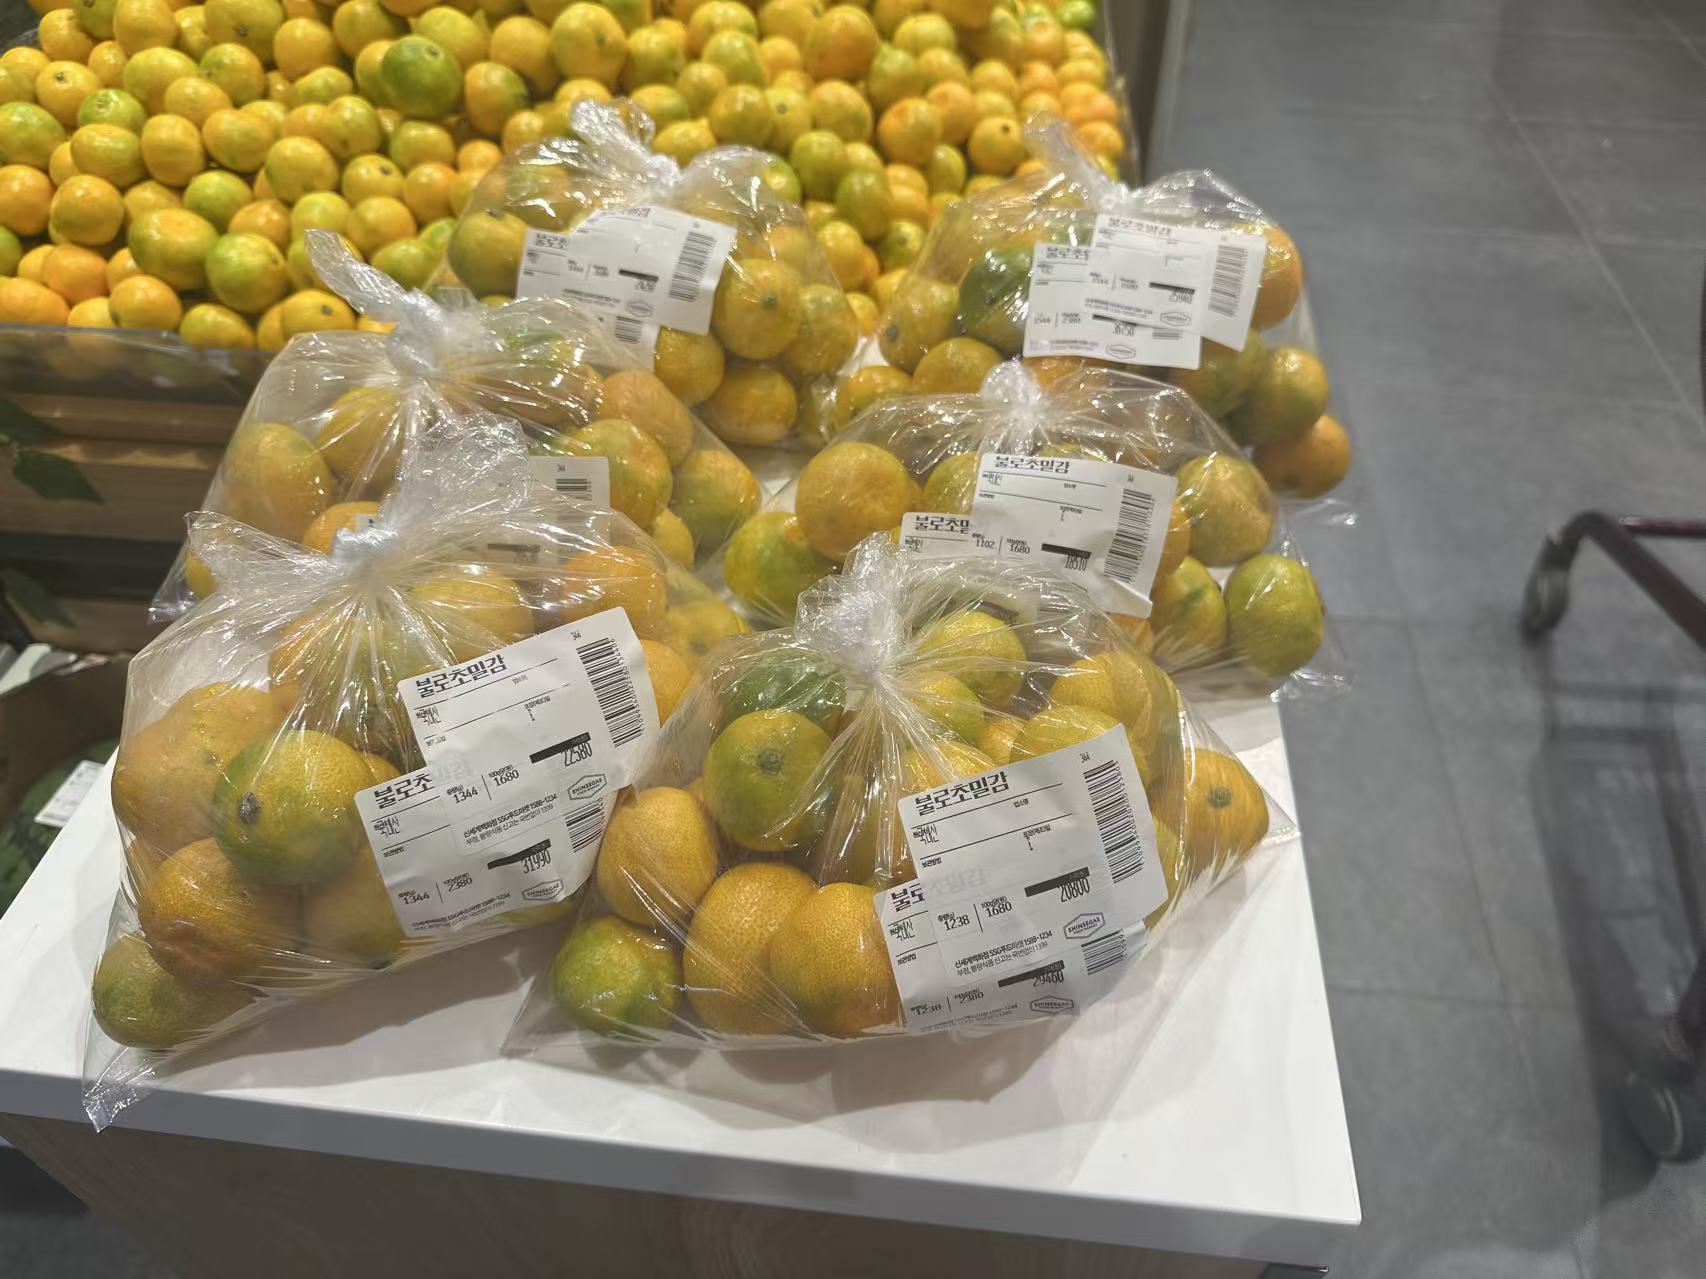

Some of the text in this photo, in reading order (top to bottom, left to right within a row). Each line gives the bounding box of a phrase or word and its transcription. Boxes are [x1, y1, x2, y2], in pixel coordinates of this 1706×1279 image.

[995, 456, 1070, 474] 불로초밀감
[975, 539, 996, 549] 1102
[1009, 544, 1030, 555] 1680
[1064, 555, 1088, 572] 18510
[416, 654, 507, 698] 불로초밀감
[561, 741, 592, 767] 22580
[1080, 752, 1090, 763] 344
[493, 769, 519, 787] 1680
[374, 773, 435, 809] 불로초
[453, 786, 478, 804] 1344
[915, 771, 1009, 816] 불로초밀감
[530, 793, 558, 810] 1588-1234
[520, 850, 552, 874] 31990
[448, 877, 473, 892] 2380
[1061, 876, 1090, 902] 20800
[402, 891, 430, 905] 1344
[985, 901, 1012, 917] 1680
[944, 915, 970, 931] 1238
[1068, 917, 1099, 932] SHINSEGAE
[1024, 930, 1052, 946] 1588-1234
[1033, 970, 1064, 987] 29460
